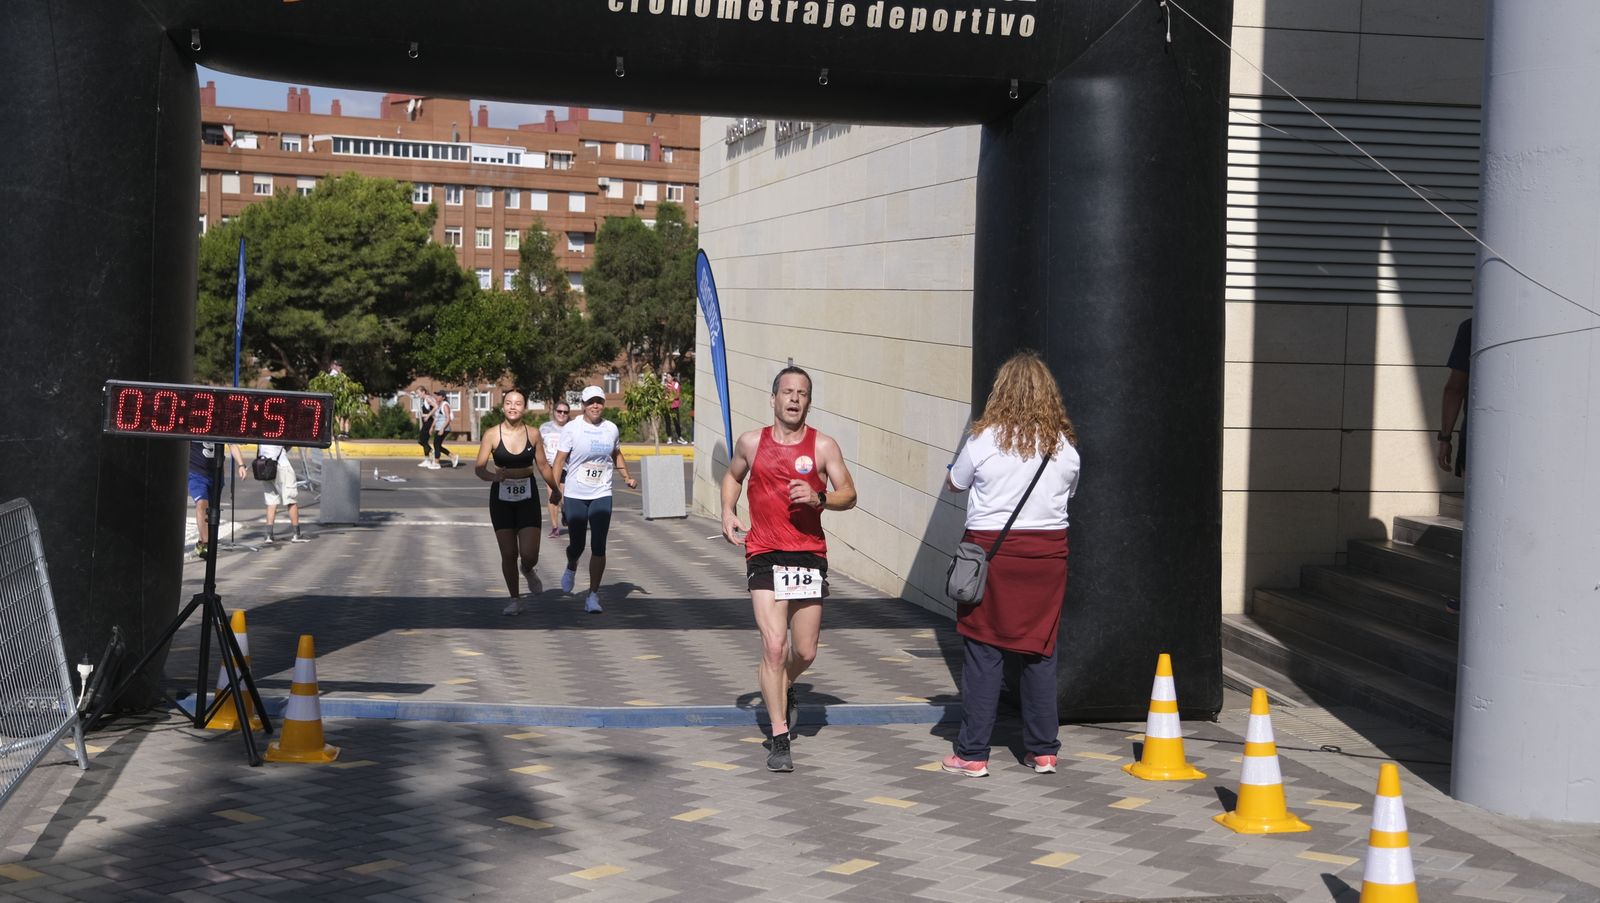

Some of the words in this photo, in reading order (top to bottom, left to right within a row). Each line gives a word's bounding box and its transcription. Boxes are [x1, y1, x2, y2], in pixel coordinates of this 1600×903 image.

[607, 0, 856, 29] cronometraje
[866, 0, 1036, 38] deportivo
[117, 388, 322, 437] 00:37:57
[585, 469, 603, 478] 187
[506, 485, 526, 495] 188
[781, 573, 813, 586] 118
